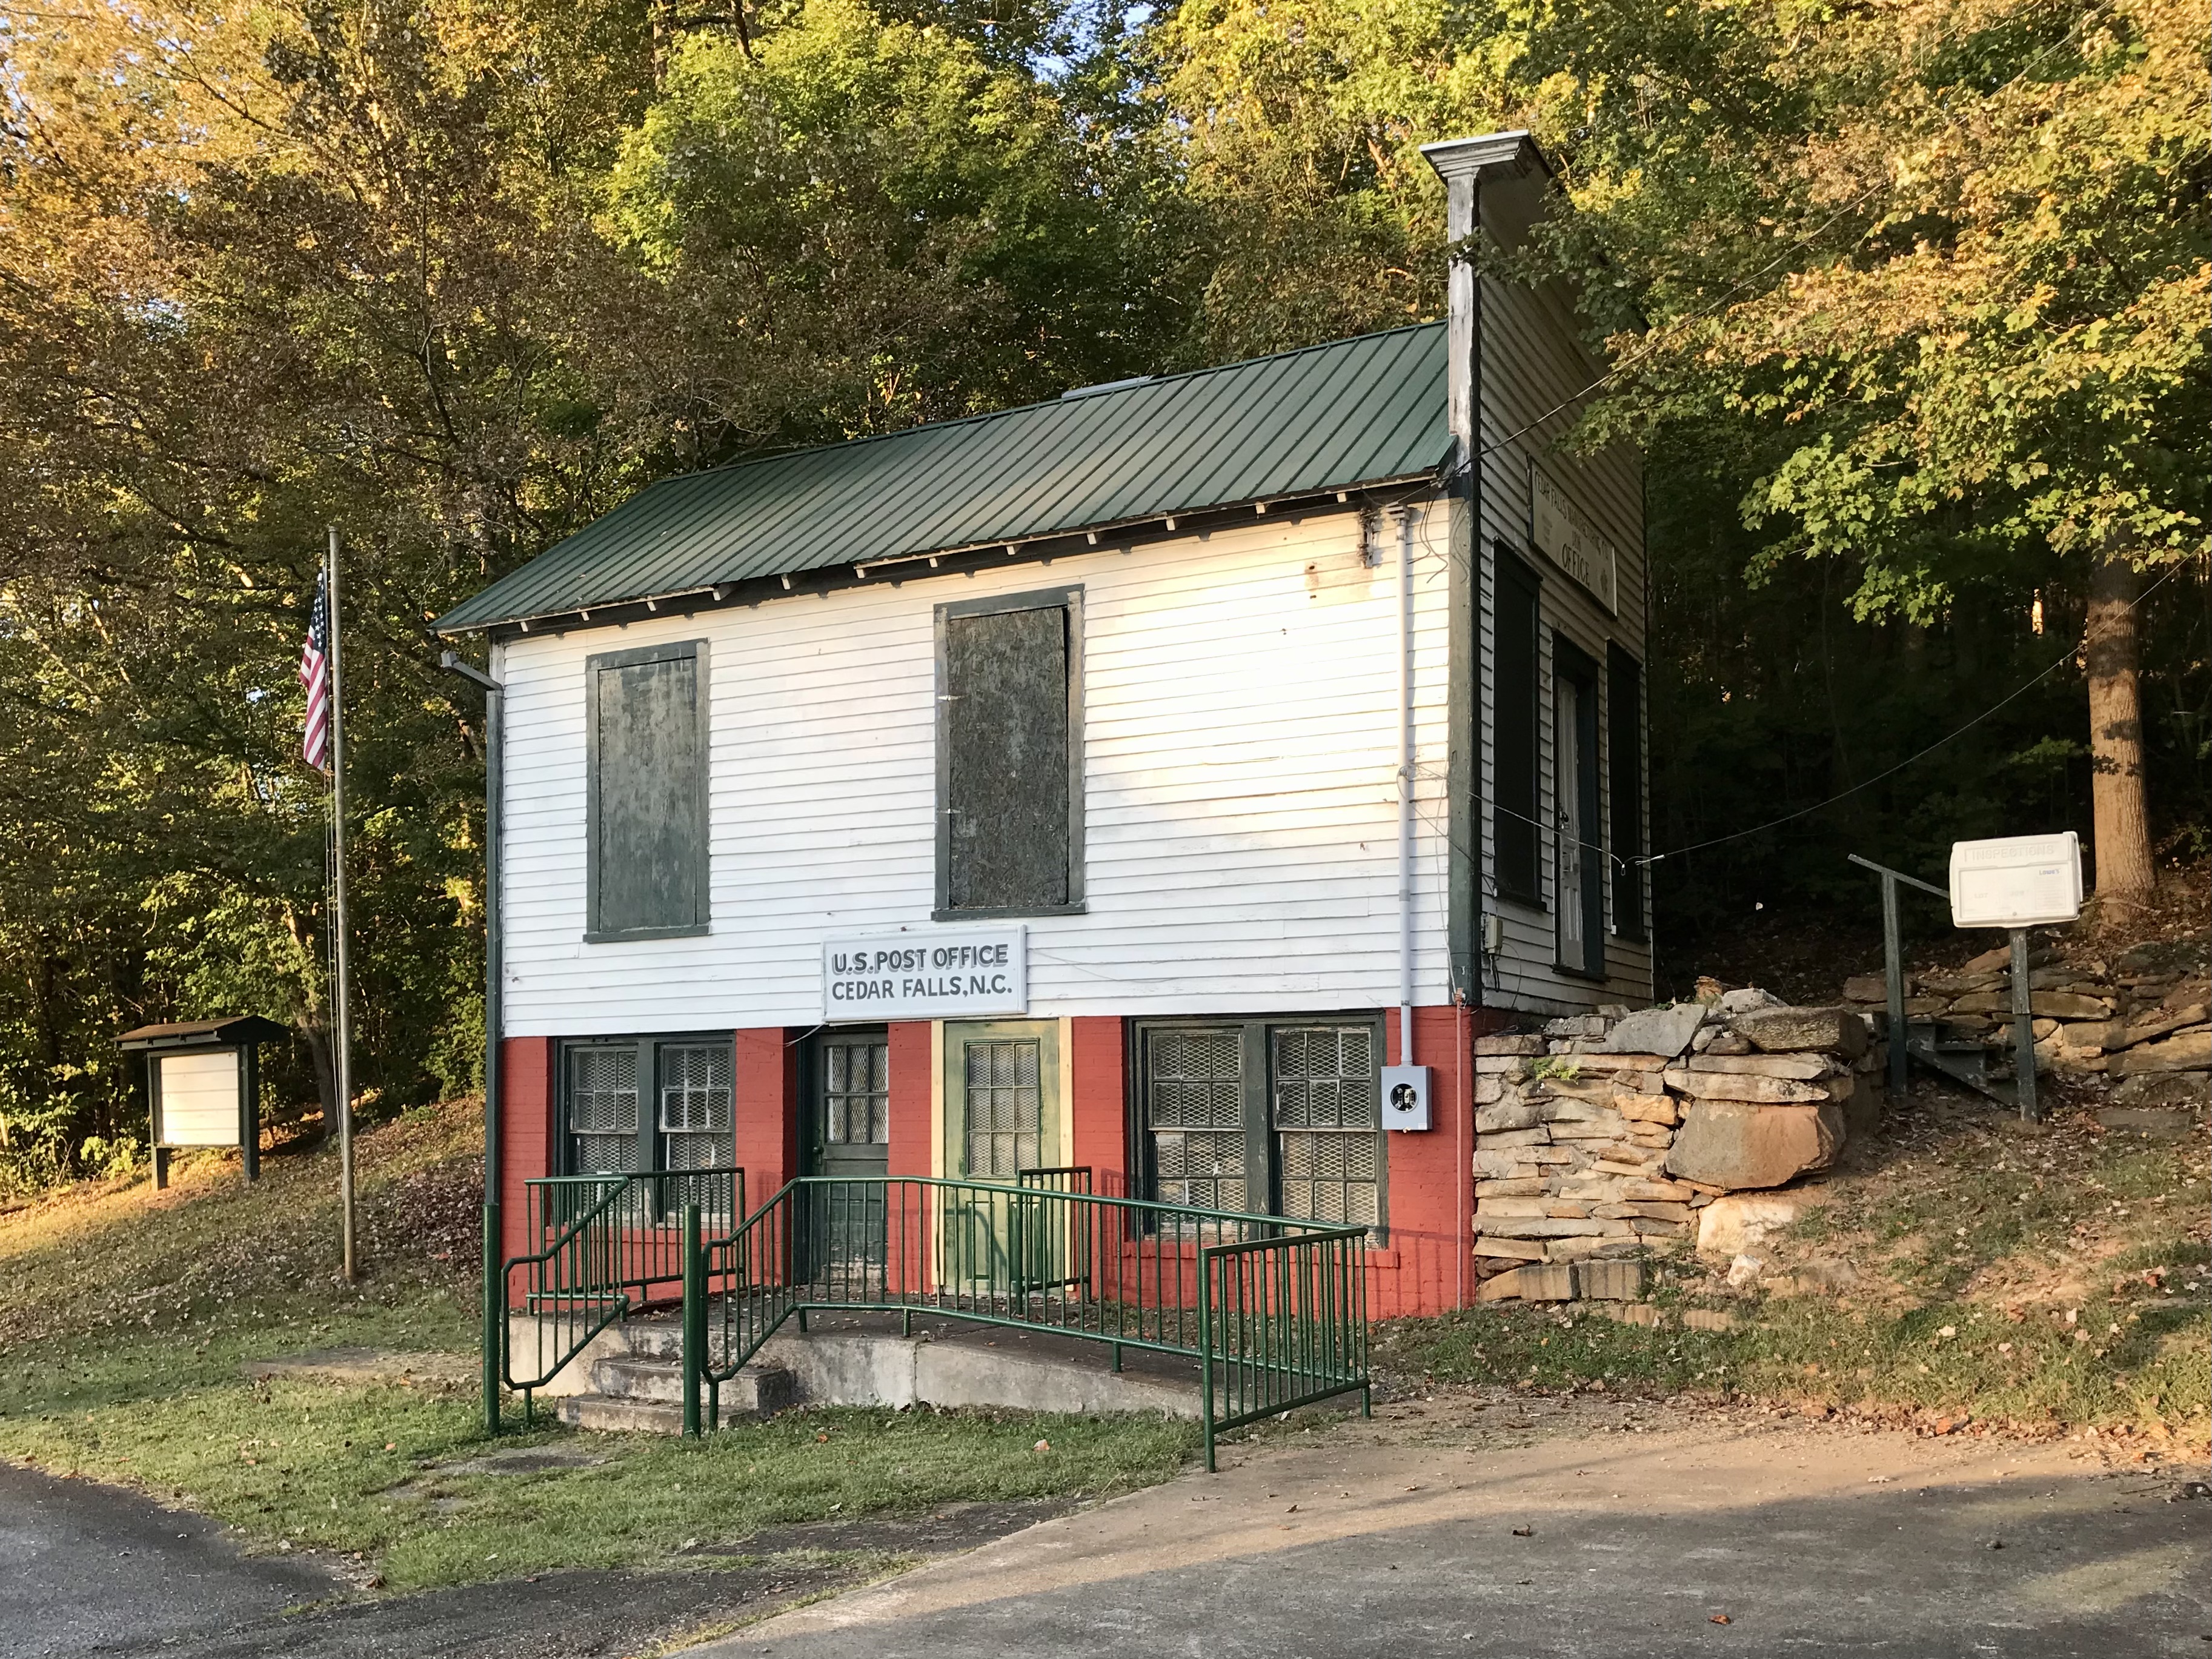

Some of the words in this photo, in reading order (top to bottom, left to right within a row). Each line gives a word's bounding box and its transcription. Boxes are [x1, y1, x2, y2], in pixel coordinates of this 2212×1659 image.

[1562, 543, 1590, 587] OFFICE
[1973, 845, 2054, 860] INSPECTIONS
[931, 944, 1008, 969] OFFICE
[832, 980, 894, 1000] CEDAR
